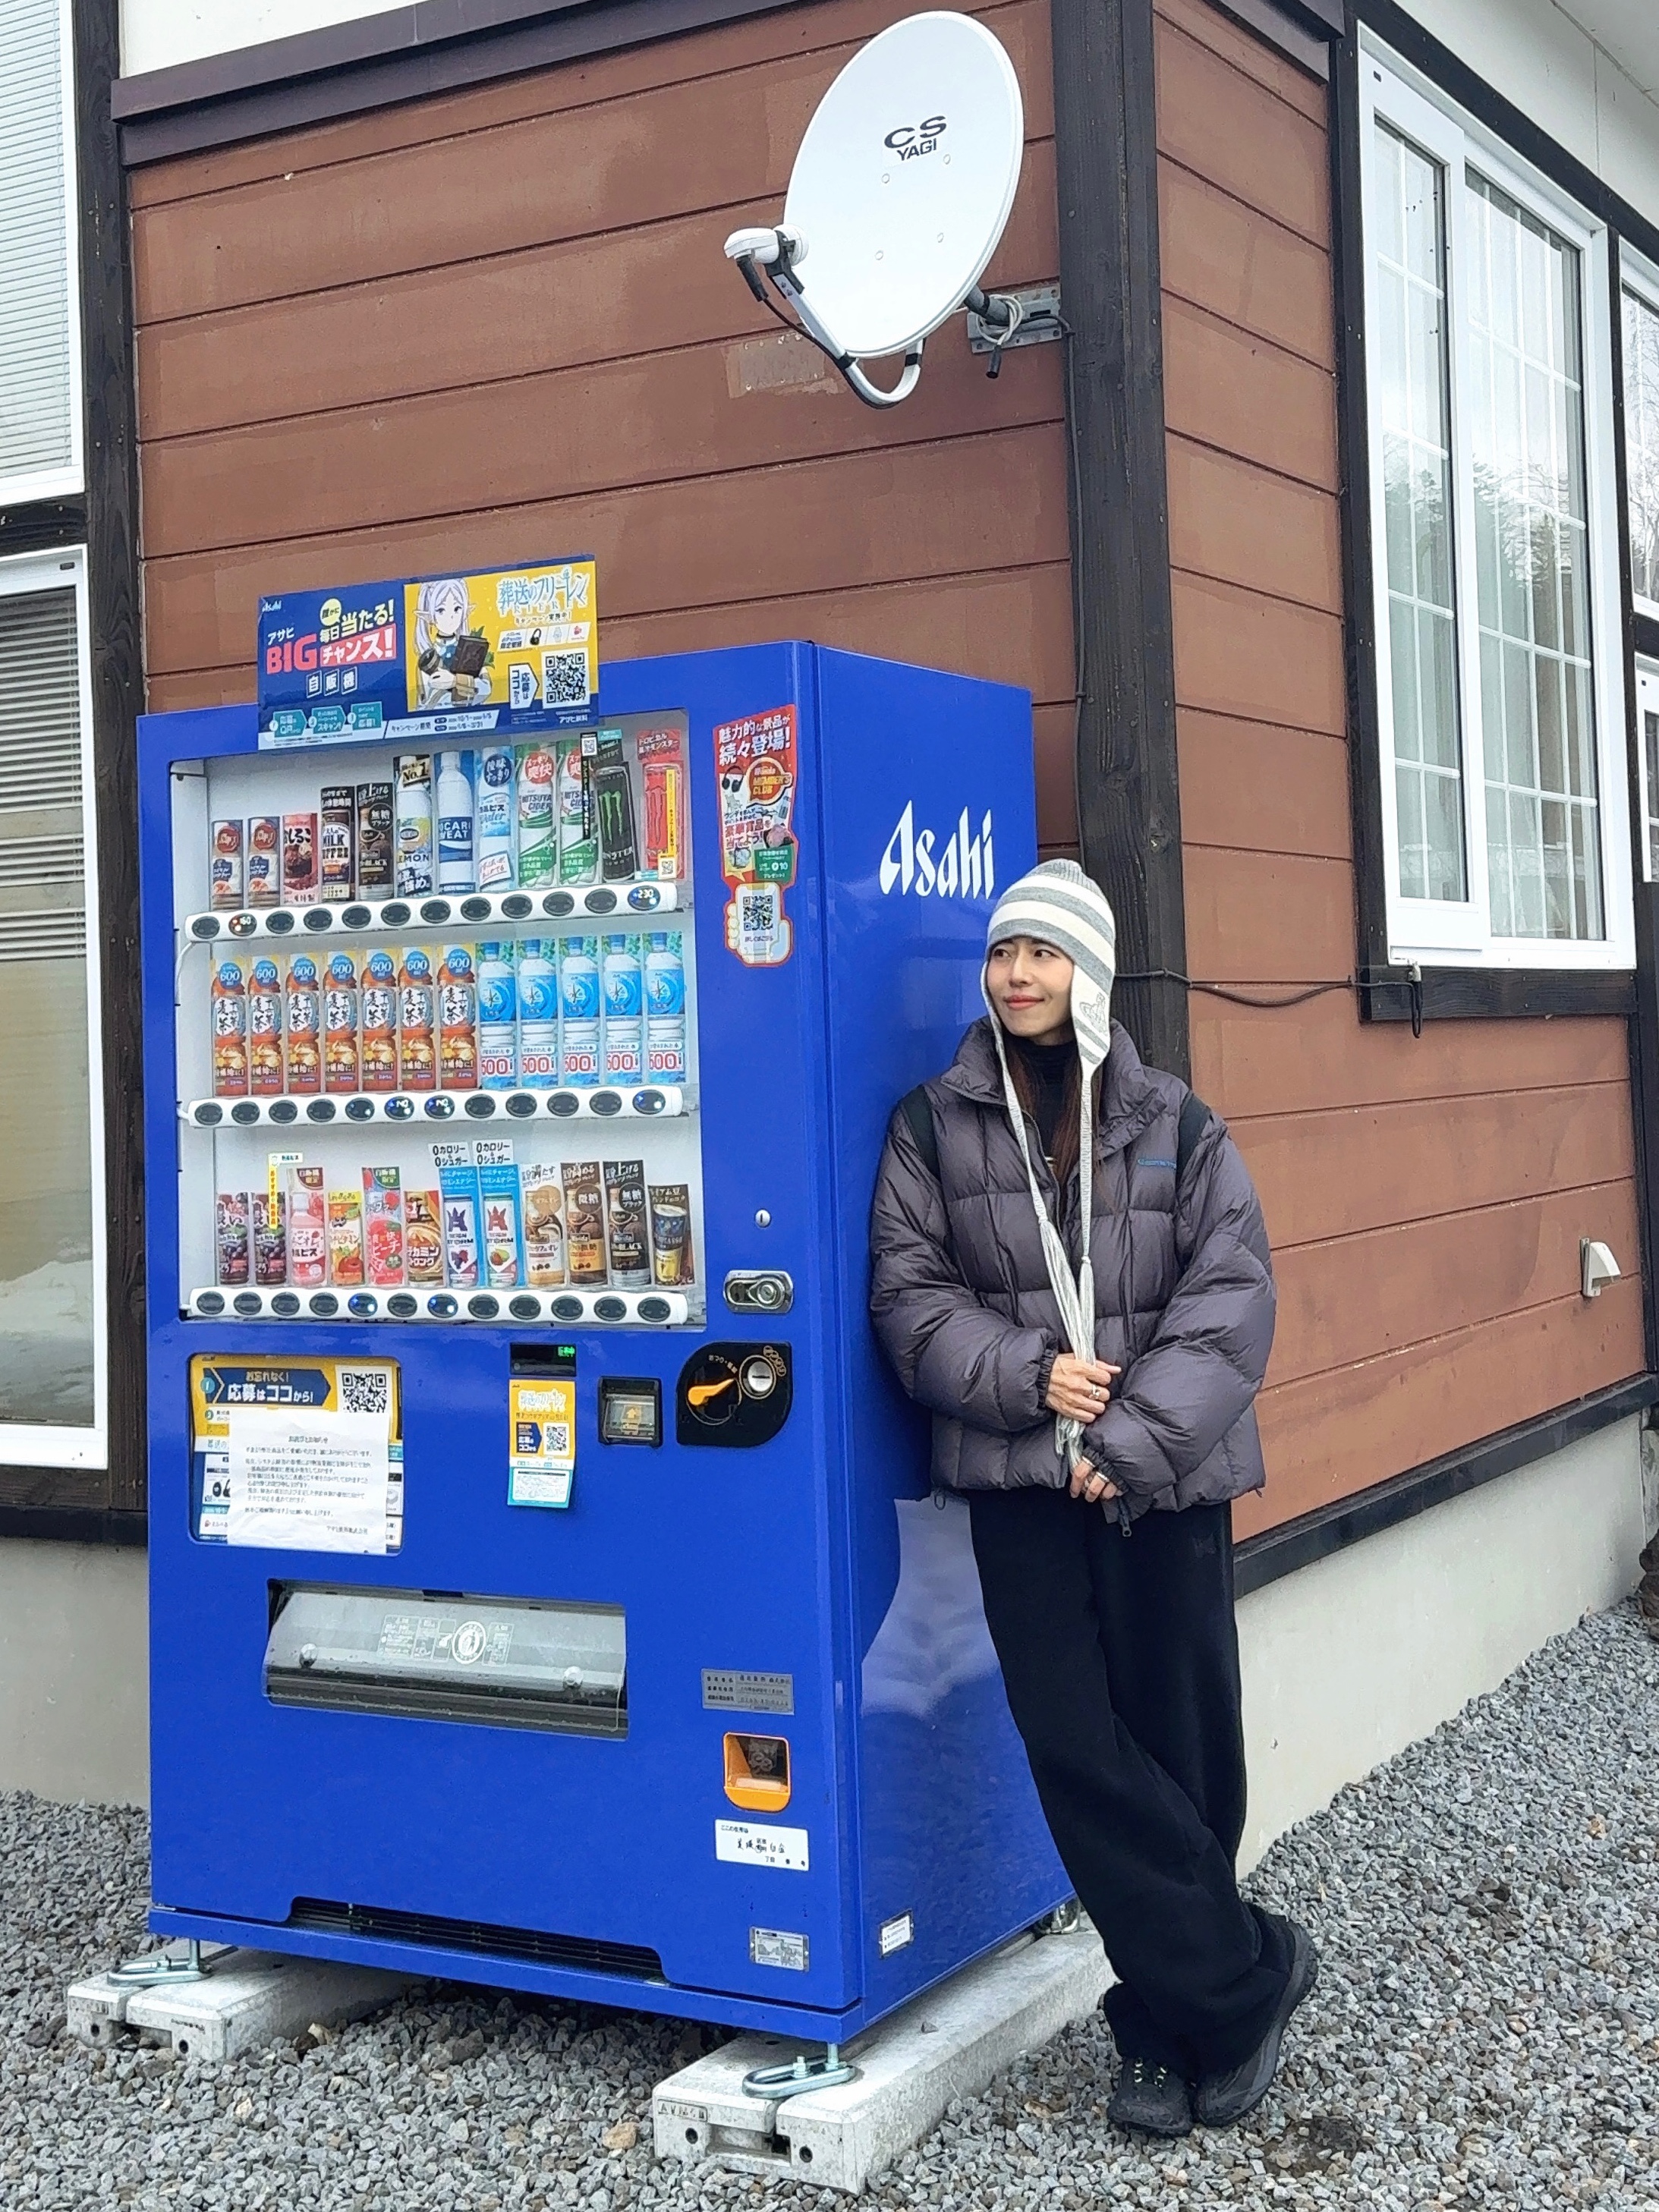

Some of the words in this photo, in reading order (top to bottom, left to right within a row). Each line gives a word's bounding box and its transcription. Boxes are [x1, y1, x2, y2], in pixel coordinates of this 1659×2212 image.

[884, 115, 946, 149] CS
[896, 137, 937, 161] YAGI
[498, 568, 588, 615] 葬送のフリーレン
[267, 627, 295, 646] アサヒ
[266, 633, 317, 675] BIG
[323, 627, 394, 665] チャンス!
[307, 669, 356, 694] 自販機
[719, 725, 791, 766] 続々登場!
[879, 799, 995, 901] Asahi
[257, 968, 275, 979] 600
[294, 966, 313, 977] 600
[332, 964, 352, 975] 600
[371, 962, 392, 973] 600
[408, 960, 427, 971] 600
[448, 958, 470, 969] 600
[220, 971, 240, 981] 600
[253, 996, 266, 1034] 麦茶
[291, 993, 304, 1033] 麦茶
[329, 992, 343, 1032] 麦茶
[367, 990, 381, 1030] 麦茶
[404, 988, 418, 1029] 麦茶
[445, 986, 460, 1024] 麦茶
[218, 999, 231, 1035] 麦茶
[433, 1144, 466, 1156] 0カロリー
[477, 1142, 510, 1153] 0カロリー
[435, 1156, 467, 1167] 0シュガー
[477, 1153, 511, 1165] 0シュガー
[578, 1193, 599, 1205] 微糖
[622, 1190, 642, 1201] 無糖
[228, 1383, 313, 1403] 応募はココから!
